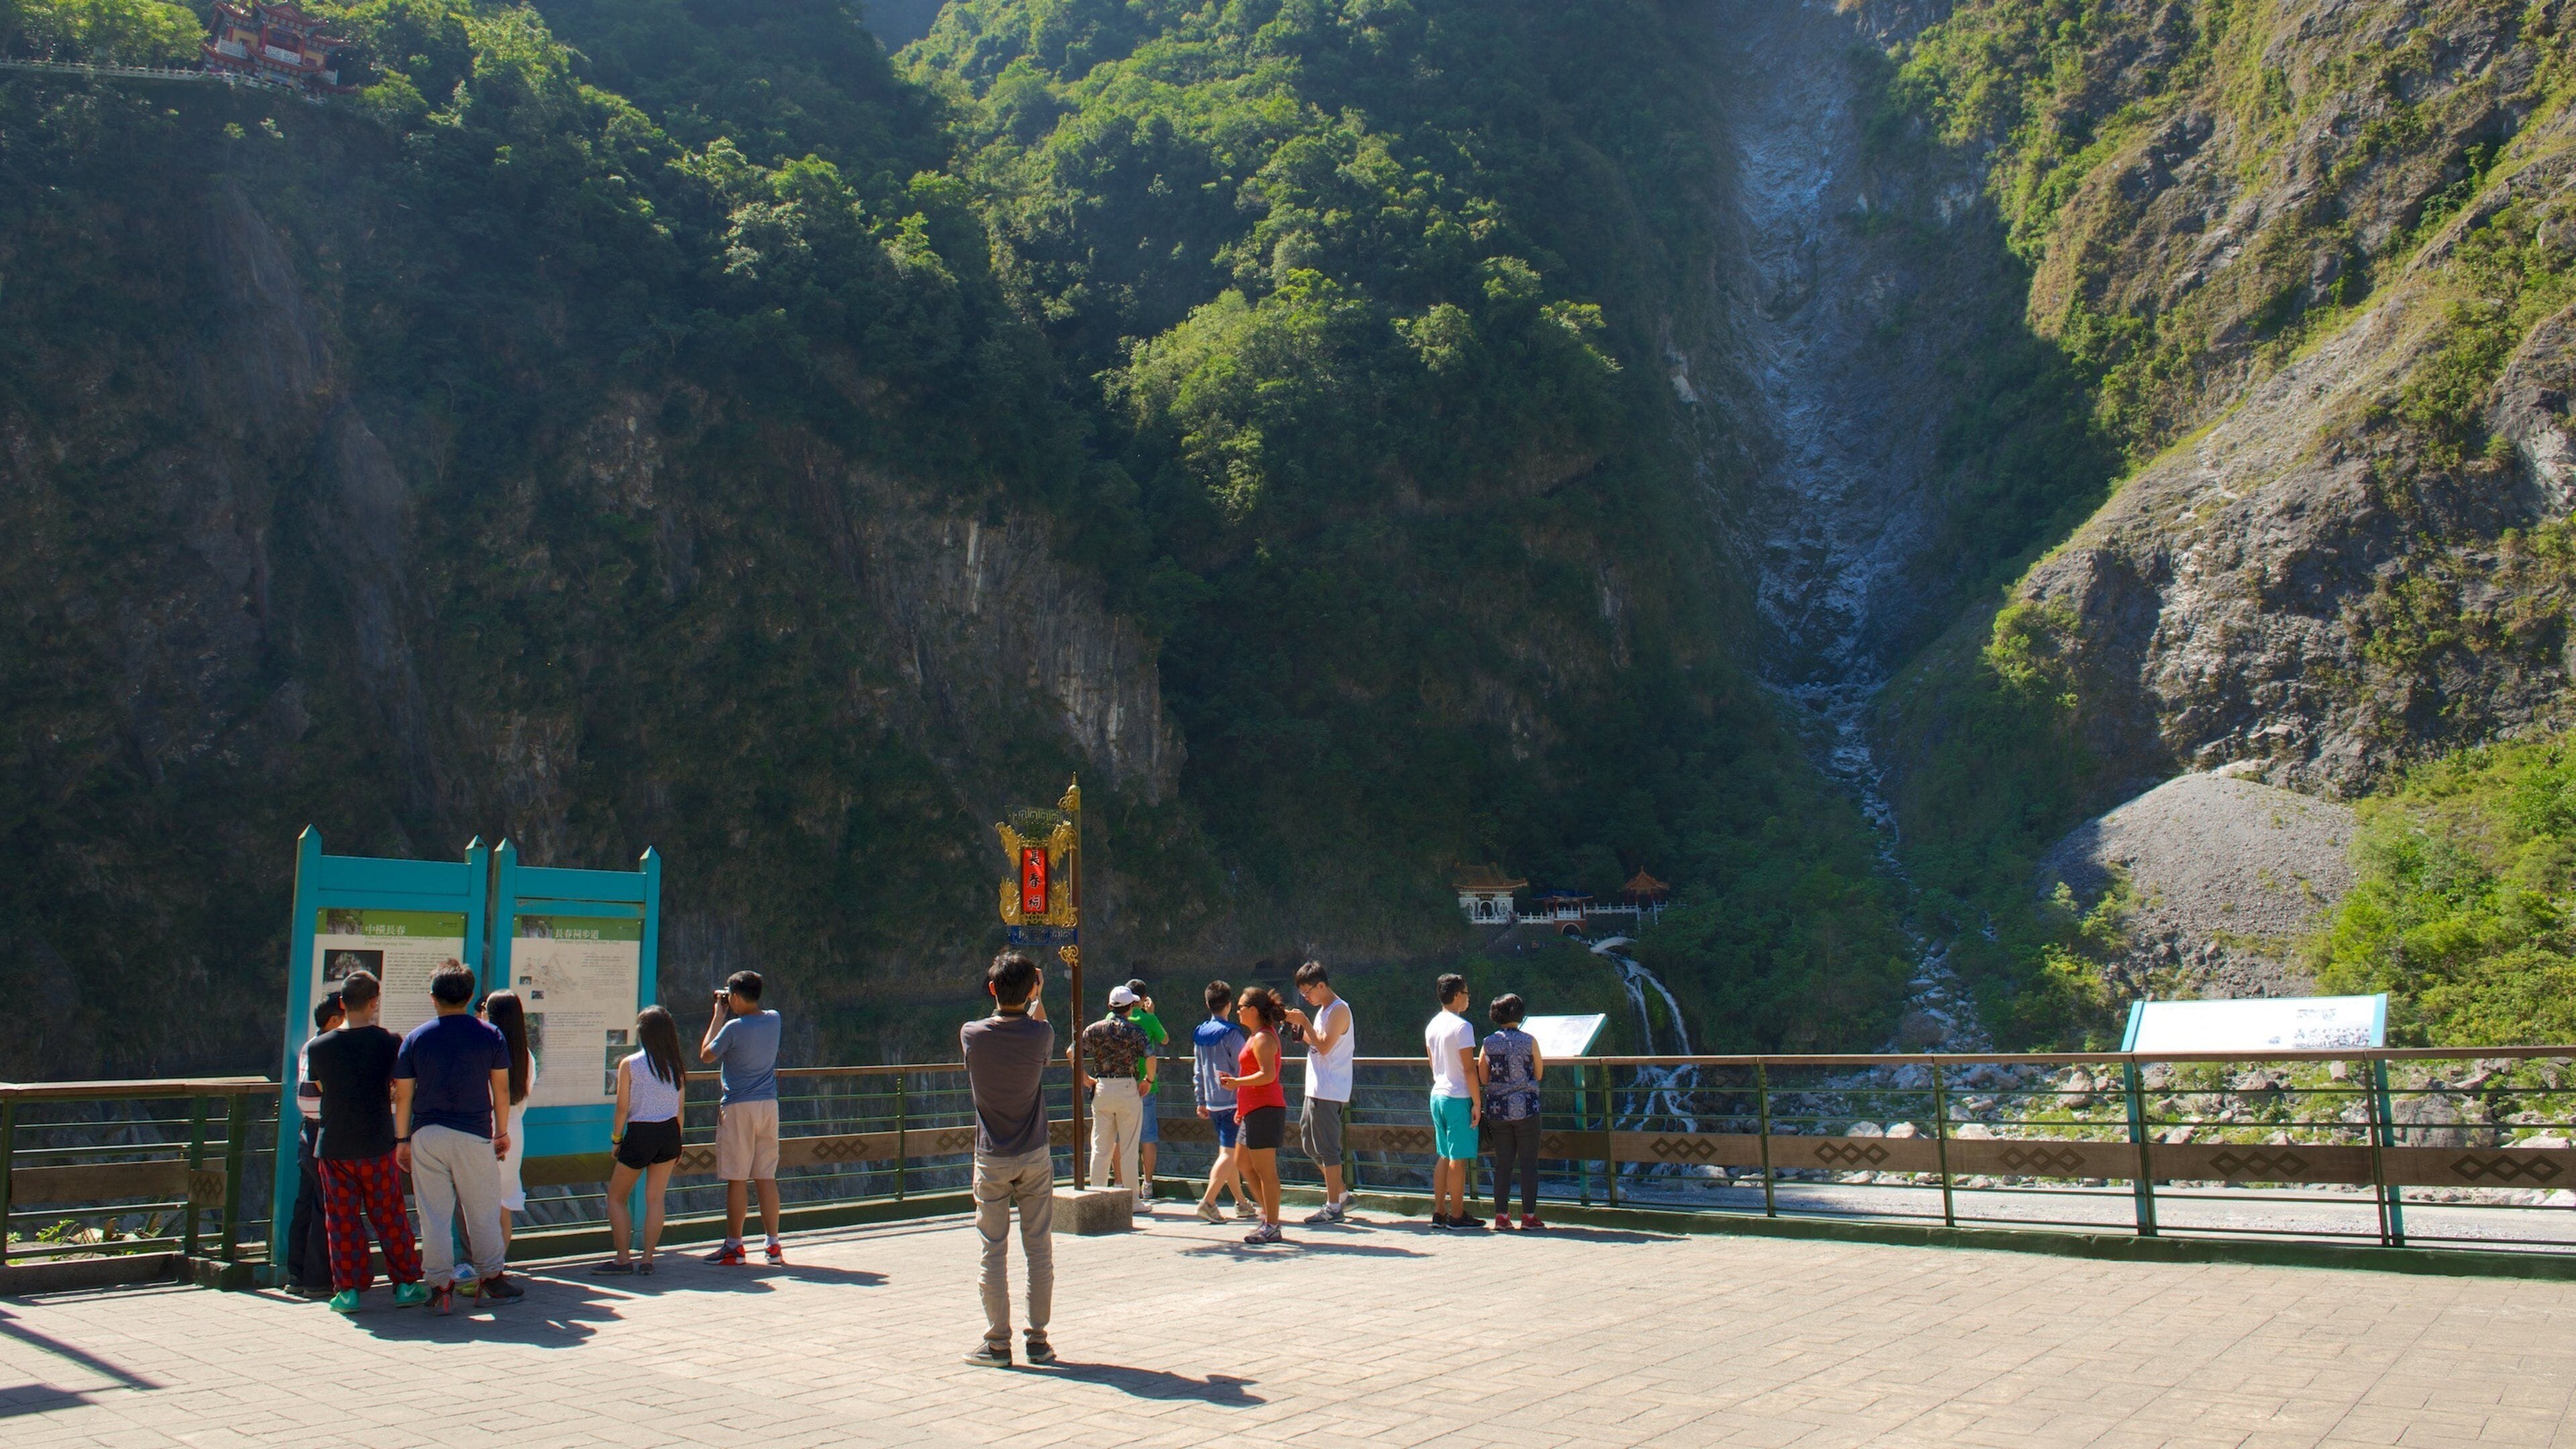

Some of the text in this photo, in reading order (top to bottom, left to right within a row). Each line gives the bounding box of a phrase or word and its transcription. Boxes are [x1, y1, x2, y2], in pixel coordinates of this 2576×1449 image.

[1027, 849, 1042, 910] 長春祠
[555, 928, 599, 939] 長春祠步道
